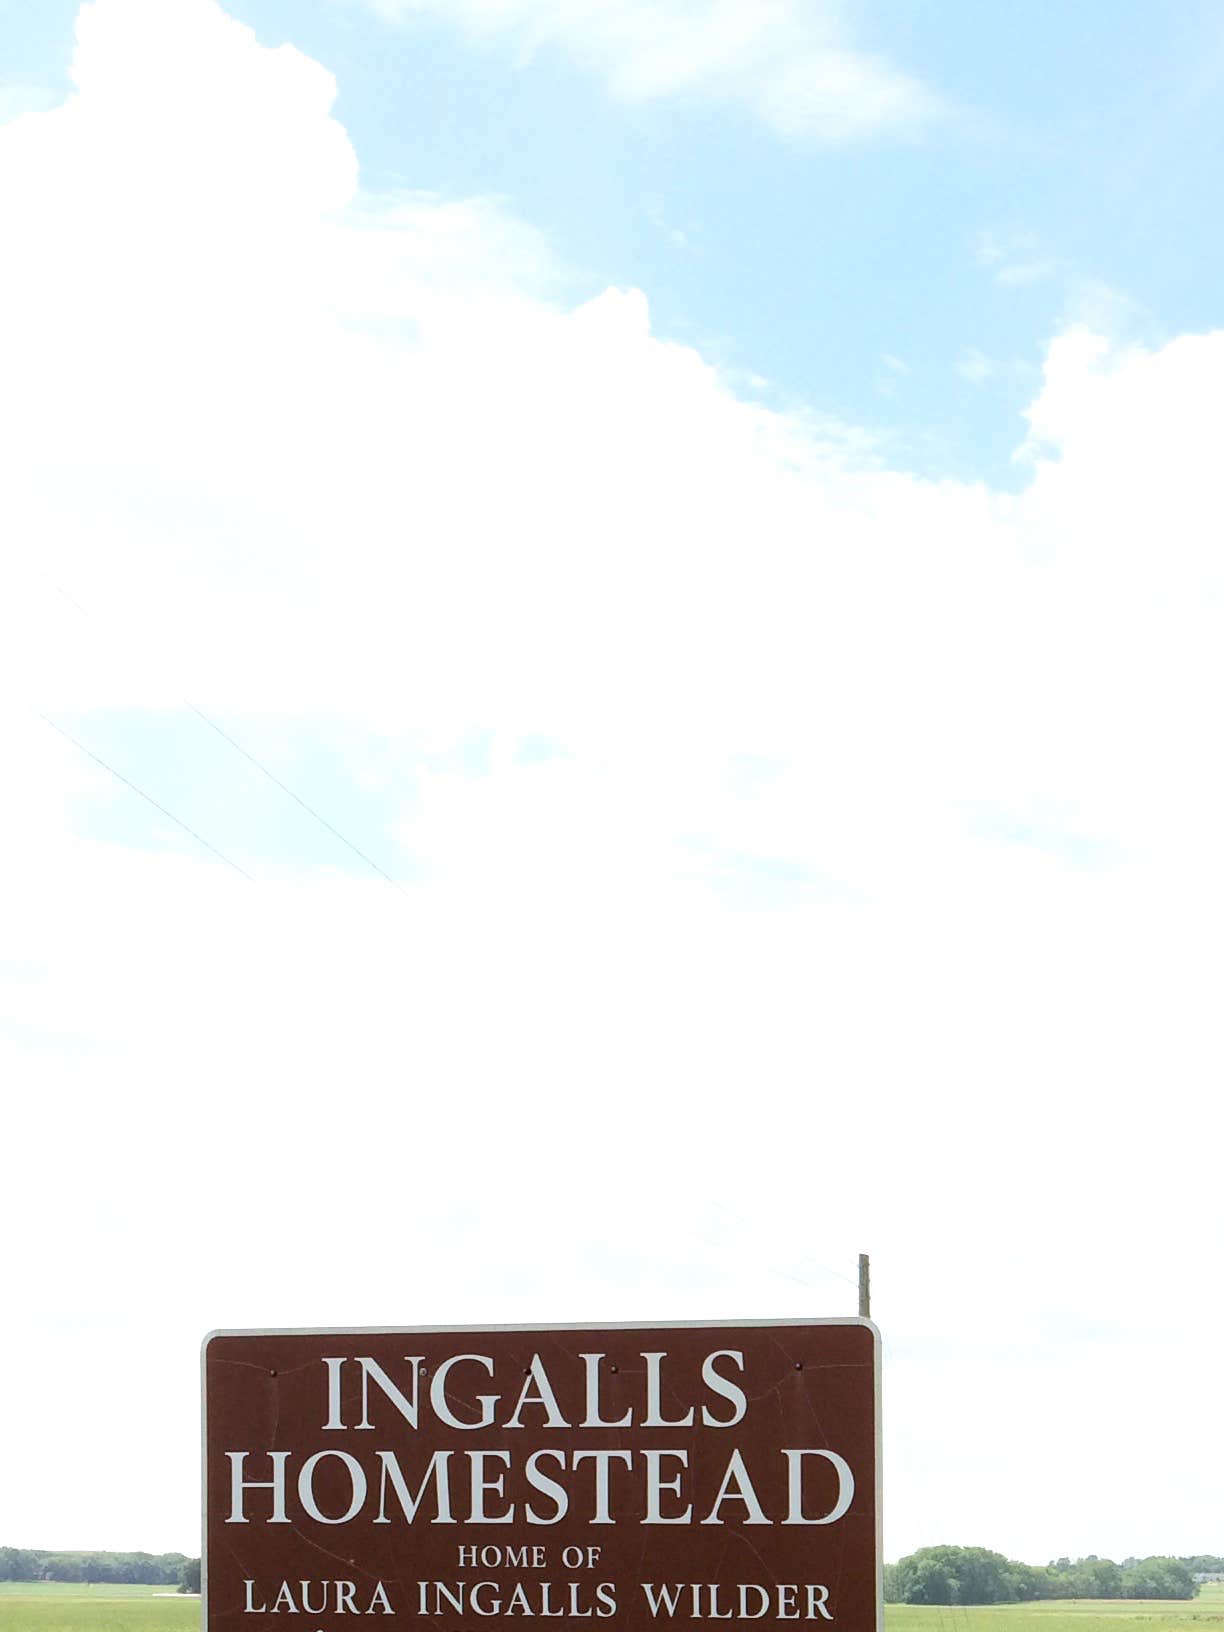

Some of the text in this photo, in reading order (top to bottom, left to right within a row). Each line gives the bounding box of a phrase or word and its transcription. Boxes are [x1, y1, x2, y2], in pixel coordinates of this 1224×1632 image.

[321, 1349, 747, 1430] INGALLS
[224, 1448, 855, 1525] HOMESTEAD
[458, 1545, 601, 1569] HOME OF
[243, 1579, 834, 1620] LAURA INGALLS WILDER
